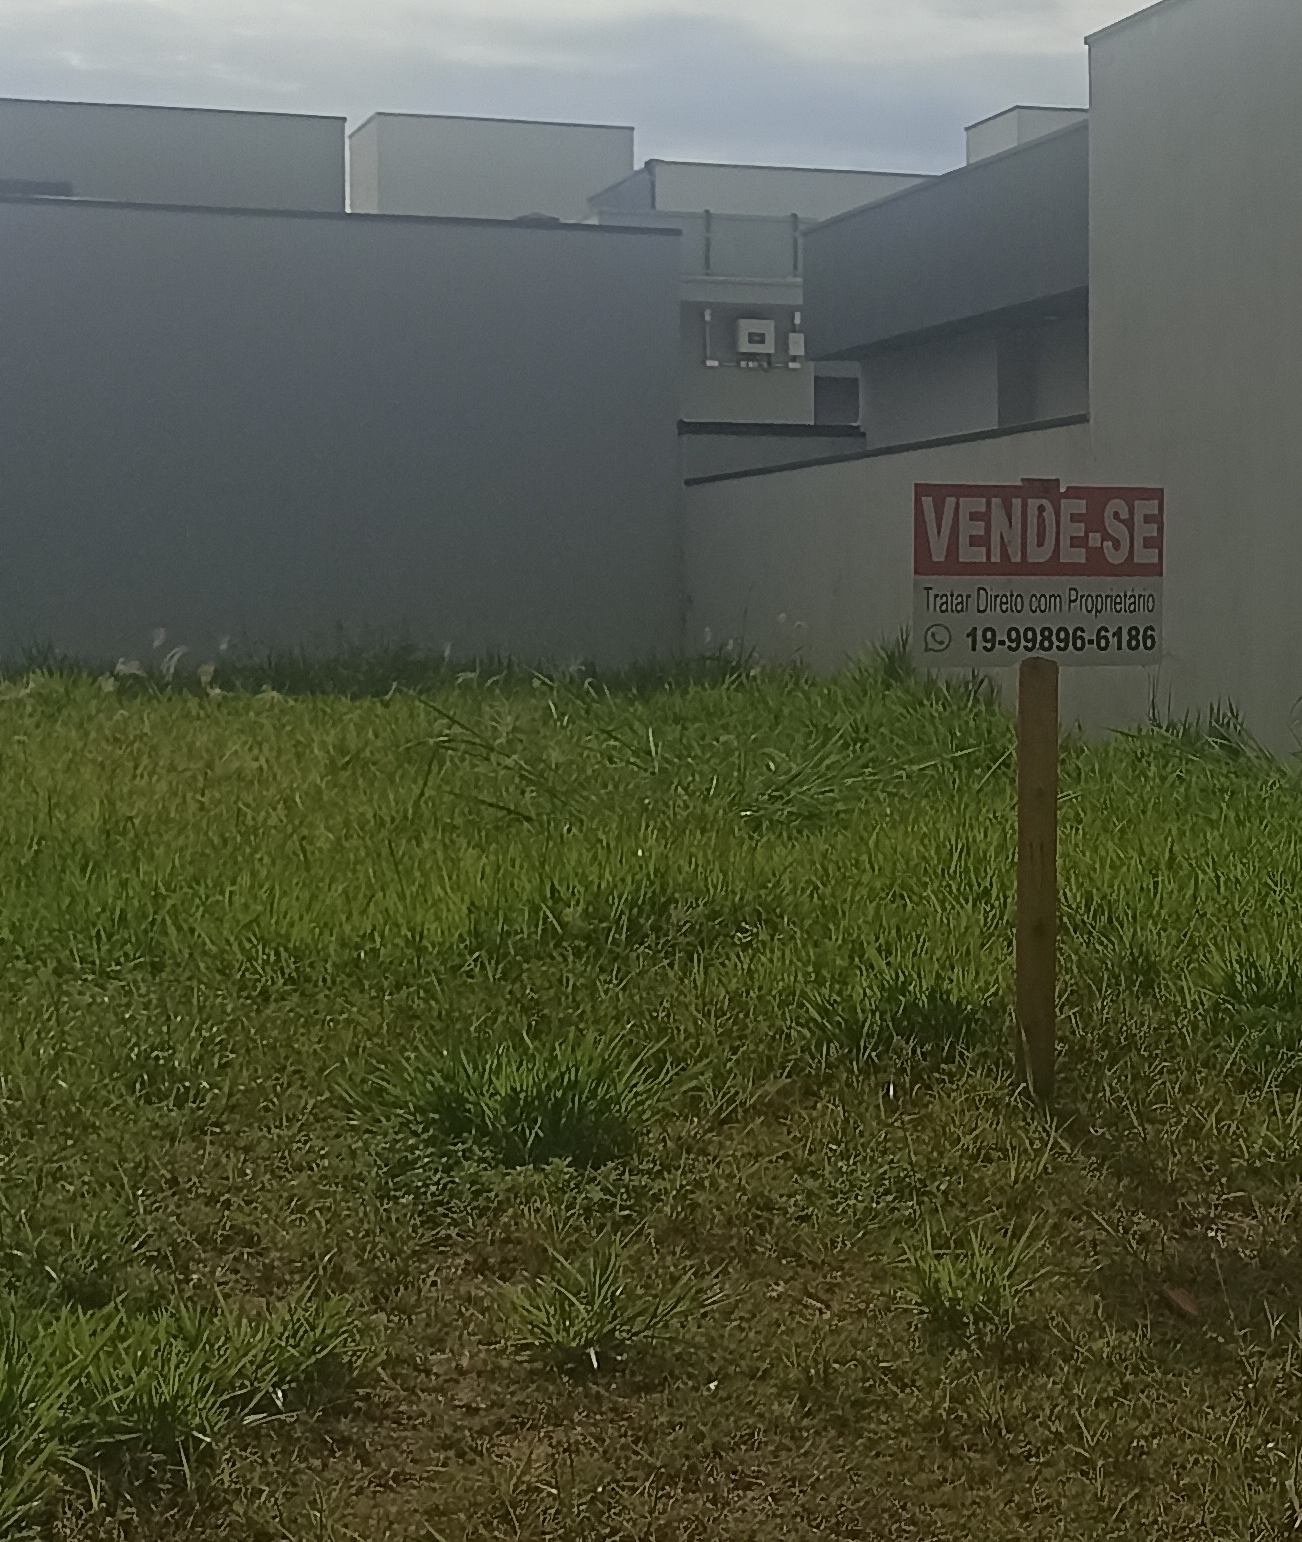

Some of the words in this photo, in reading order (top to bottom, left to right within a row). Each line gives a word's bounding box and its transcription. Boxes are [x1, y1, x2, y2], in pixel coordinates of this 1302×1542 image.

[921, 496, 1159, 565] VENDE-SE
[923, 586, 972, 614] Tratar
[975, 586, 1025, 614] Direto
[1028, 593, 1063, 614] com
[1067, 587, 1156, 619] Proprietário
[965, 625, 1157, 653] 19-99896-6186
